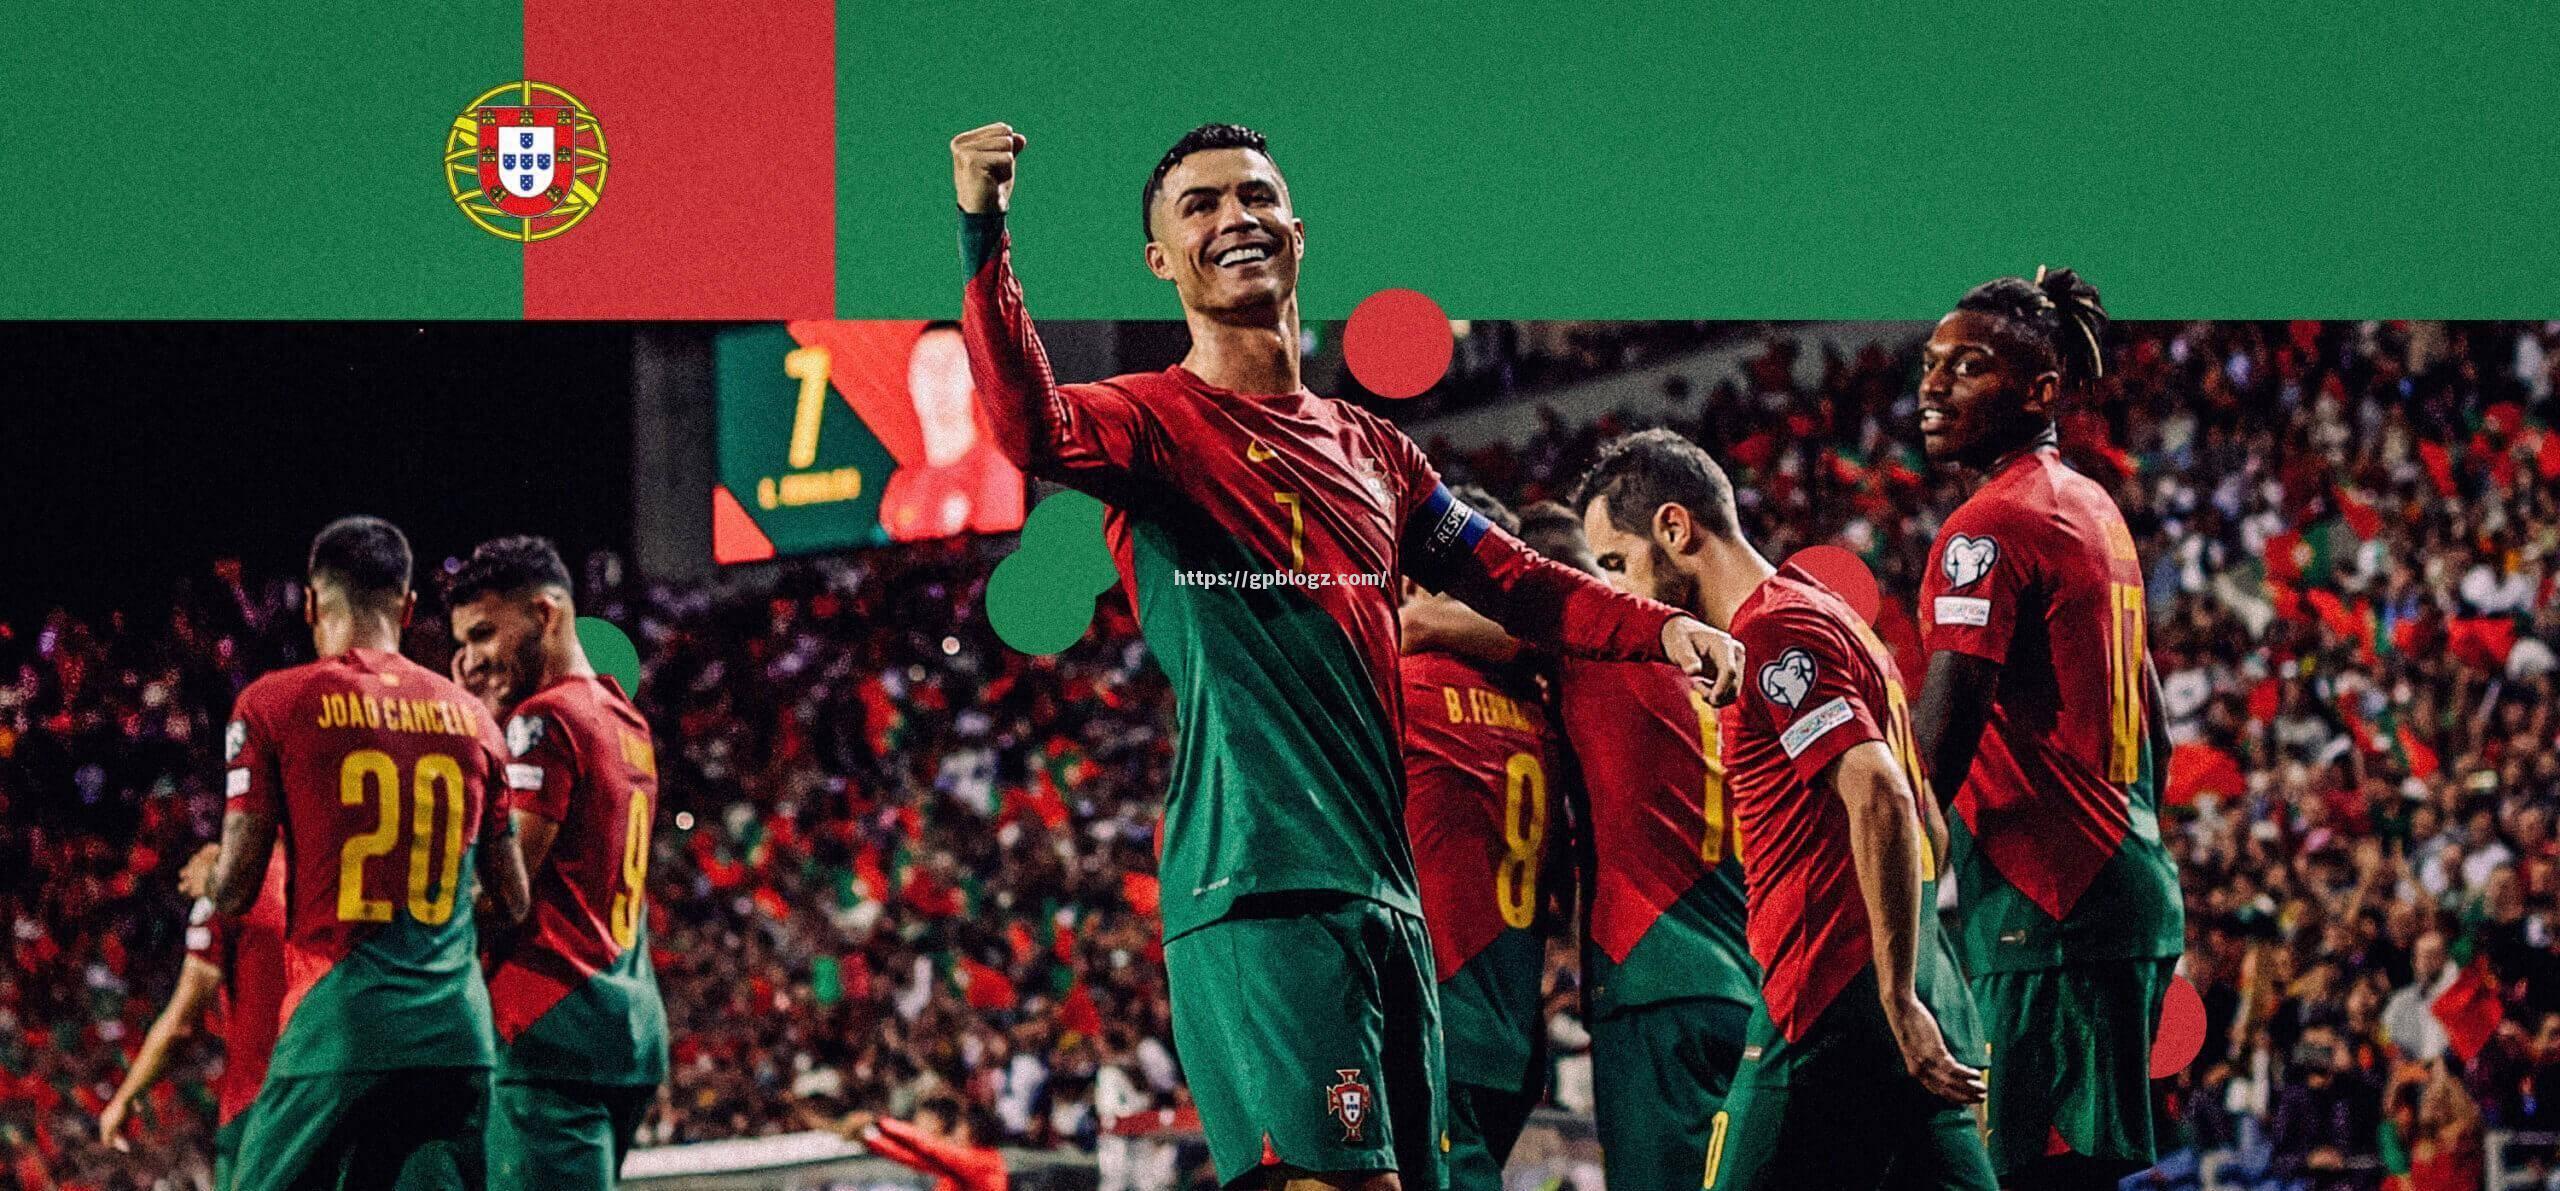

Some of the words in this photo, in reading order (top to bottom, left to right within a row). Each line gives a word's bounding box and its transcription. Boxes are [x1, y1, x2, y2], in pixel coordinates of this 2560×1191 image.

[1274, 492, 1304, 573] 7
[337, 749, 465, 925] 20
[611, 790, 649, 950] 9
[1497, 753, 1545, 928] 8
